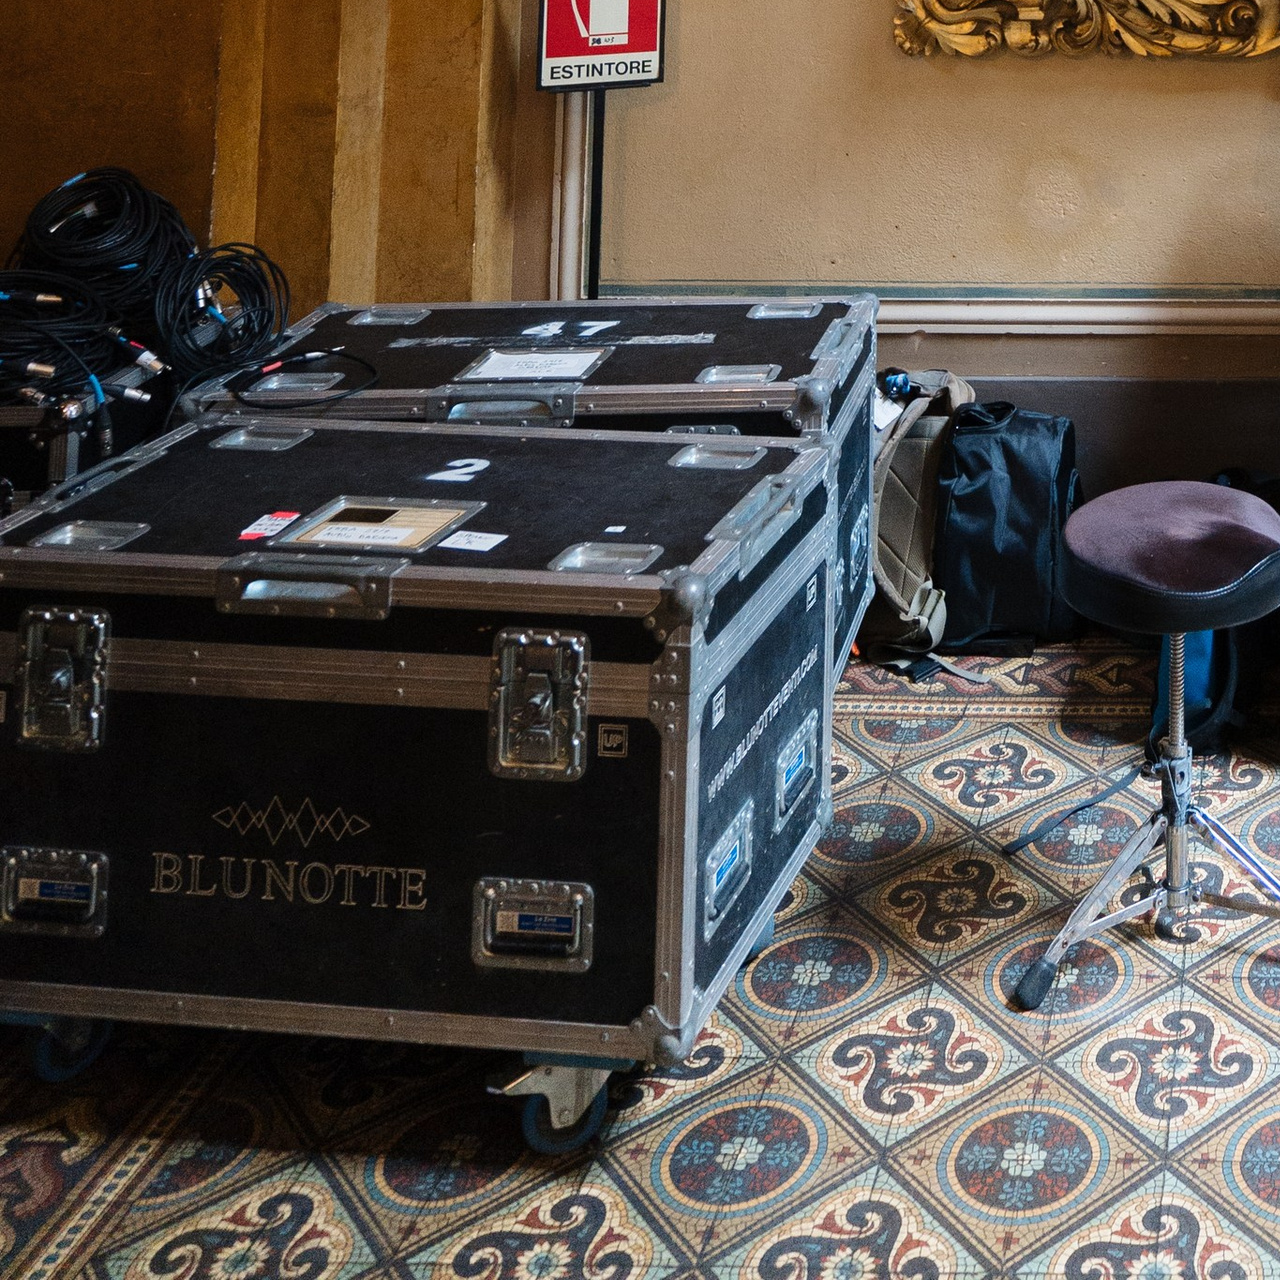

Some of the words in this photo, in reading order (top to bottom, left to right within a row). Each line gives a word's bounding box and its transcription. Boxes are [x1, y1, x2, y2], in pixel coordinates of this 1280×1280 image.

[550, 60, 652, 80] ESTINTORE
[425, 458, 491, 482] 2
[150, 852, 428, 910] BLUNOTTE
